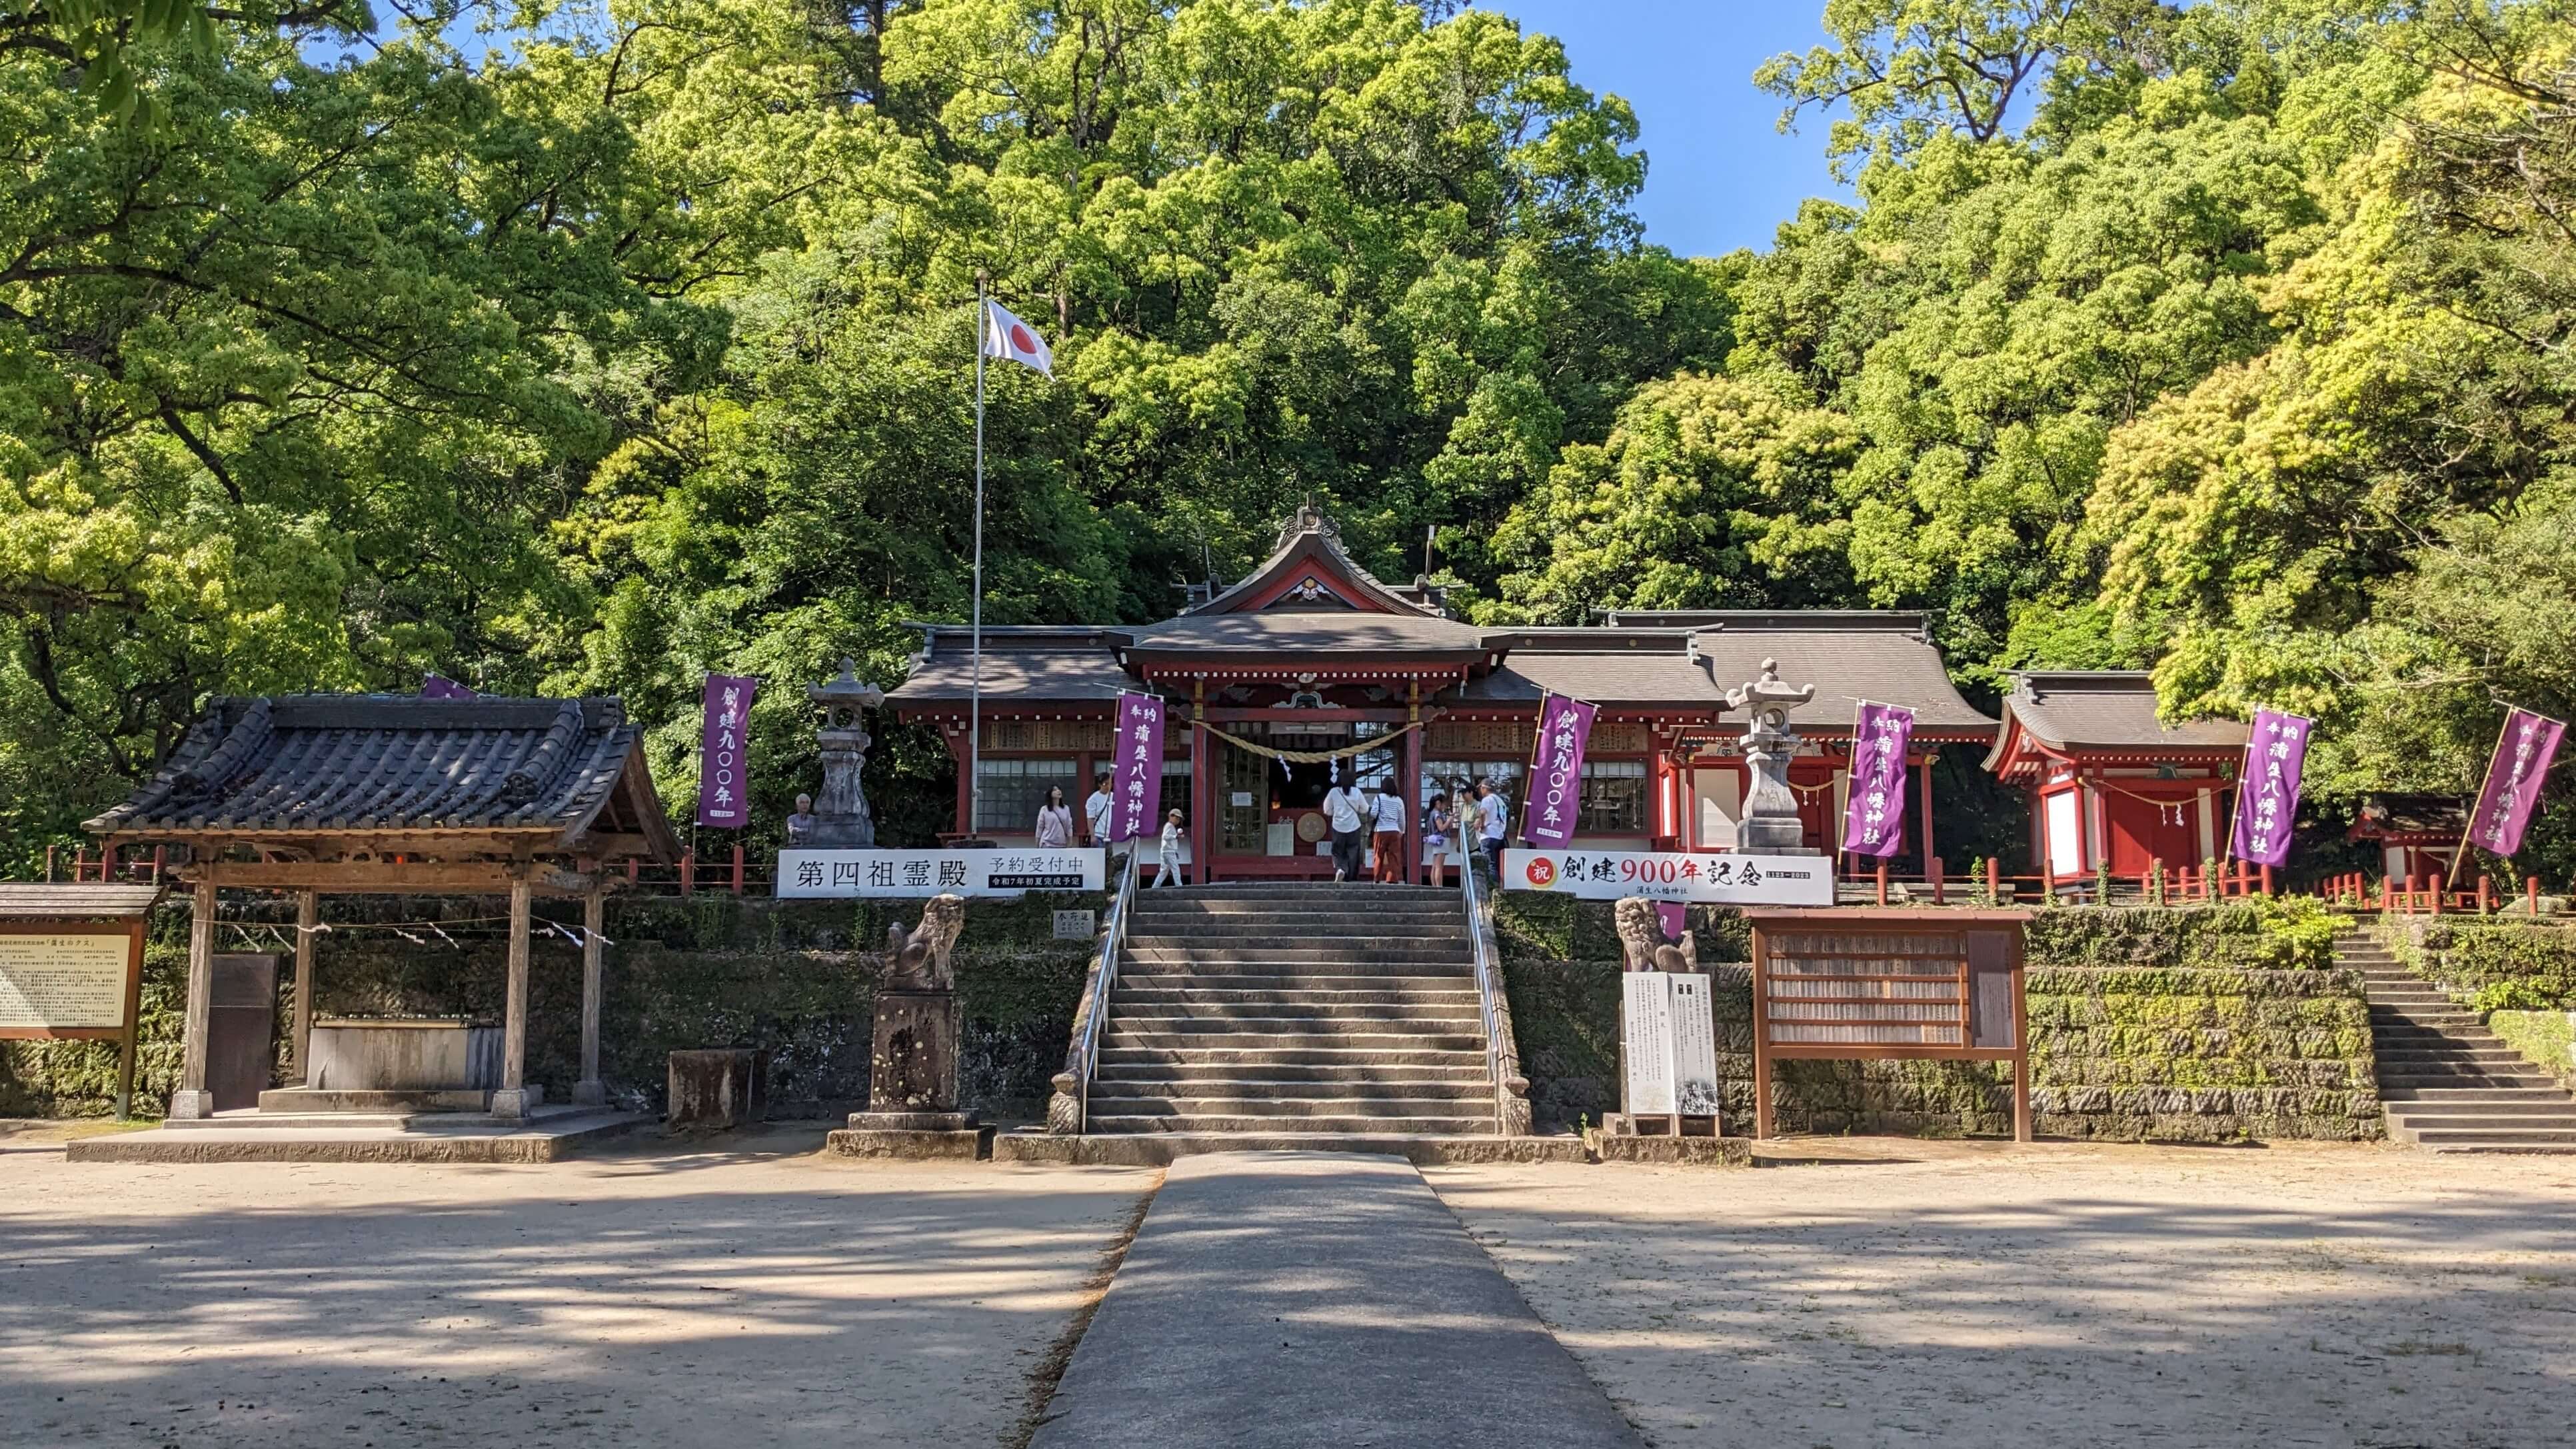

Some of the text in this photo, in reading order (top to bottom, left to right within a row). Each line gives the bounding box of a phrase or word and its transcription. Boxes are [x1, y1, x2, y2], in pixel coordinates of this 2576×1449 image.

[2266, 721, 2298, 740] 奉納
[714, 687, 740, 808] 創建九〇〇年
[1125, 724, 1150, 835] 蒲生八幡神社
[1543, 710, 1579, 827] 創建九〇〇年
[1862, 736, 1893, 845] 蒲生八幡神社
[2249, 742, 2289, 854] 蒲生八幡神社
[796, 859, 967, 888] 第四祖霊殿
[989, 856, 1083, 872] 予約受付中
[1533, 868, 1550, 880] 祝
[992, 876, 1080, 886] 令和7年初夏完成予定
[1636, 886, 1688, 895] 蒲生八幡神社
